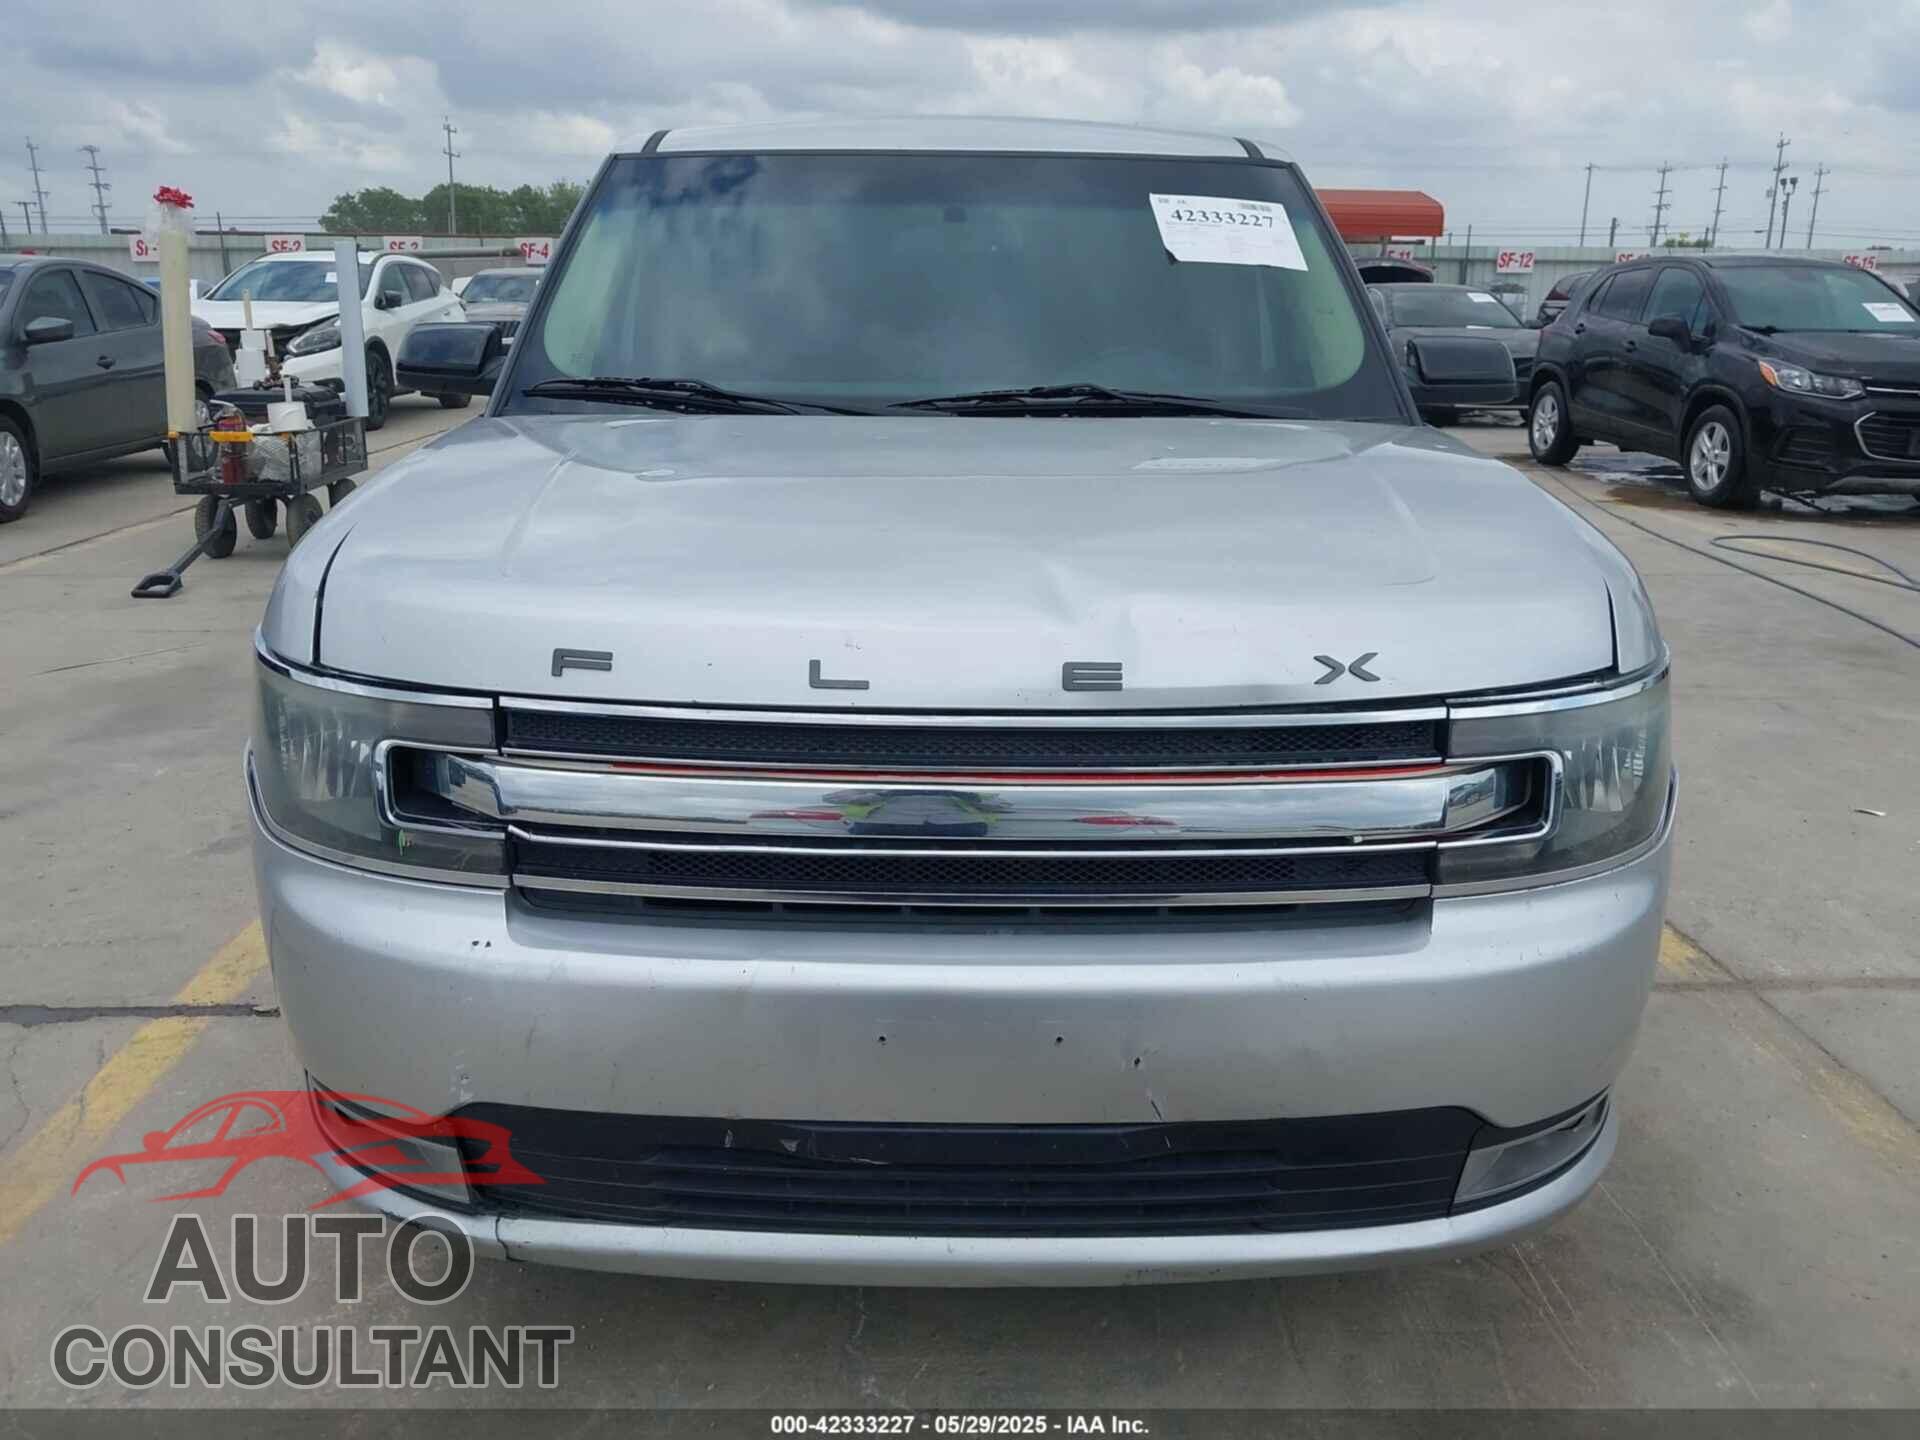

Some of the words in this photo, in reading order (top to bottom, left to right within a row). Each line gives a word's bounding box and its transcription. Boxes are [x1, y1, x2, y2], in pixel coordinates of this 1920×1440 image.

[1171, 209, 1273, 229] 42333227
[519, 241, 550, 259] SF-4
[1498, 251, 1534, 269] SF-12
[552, 648, 1380, 691] FLEX
